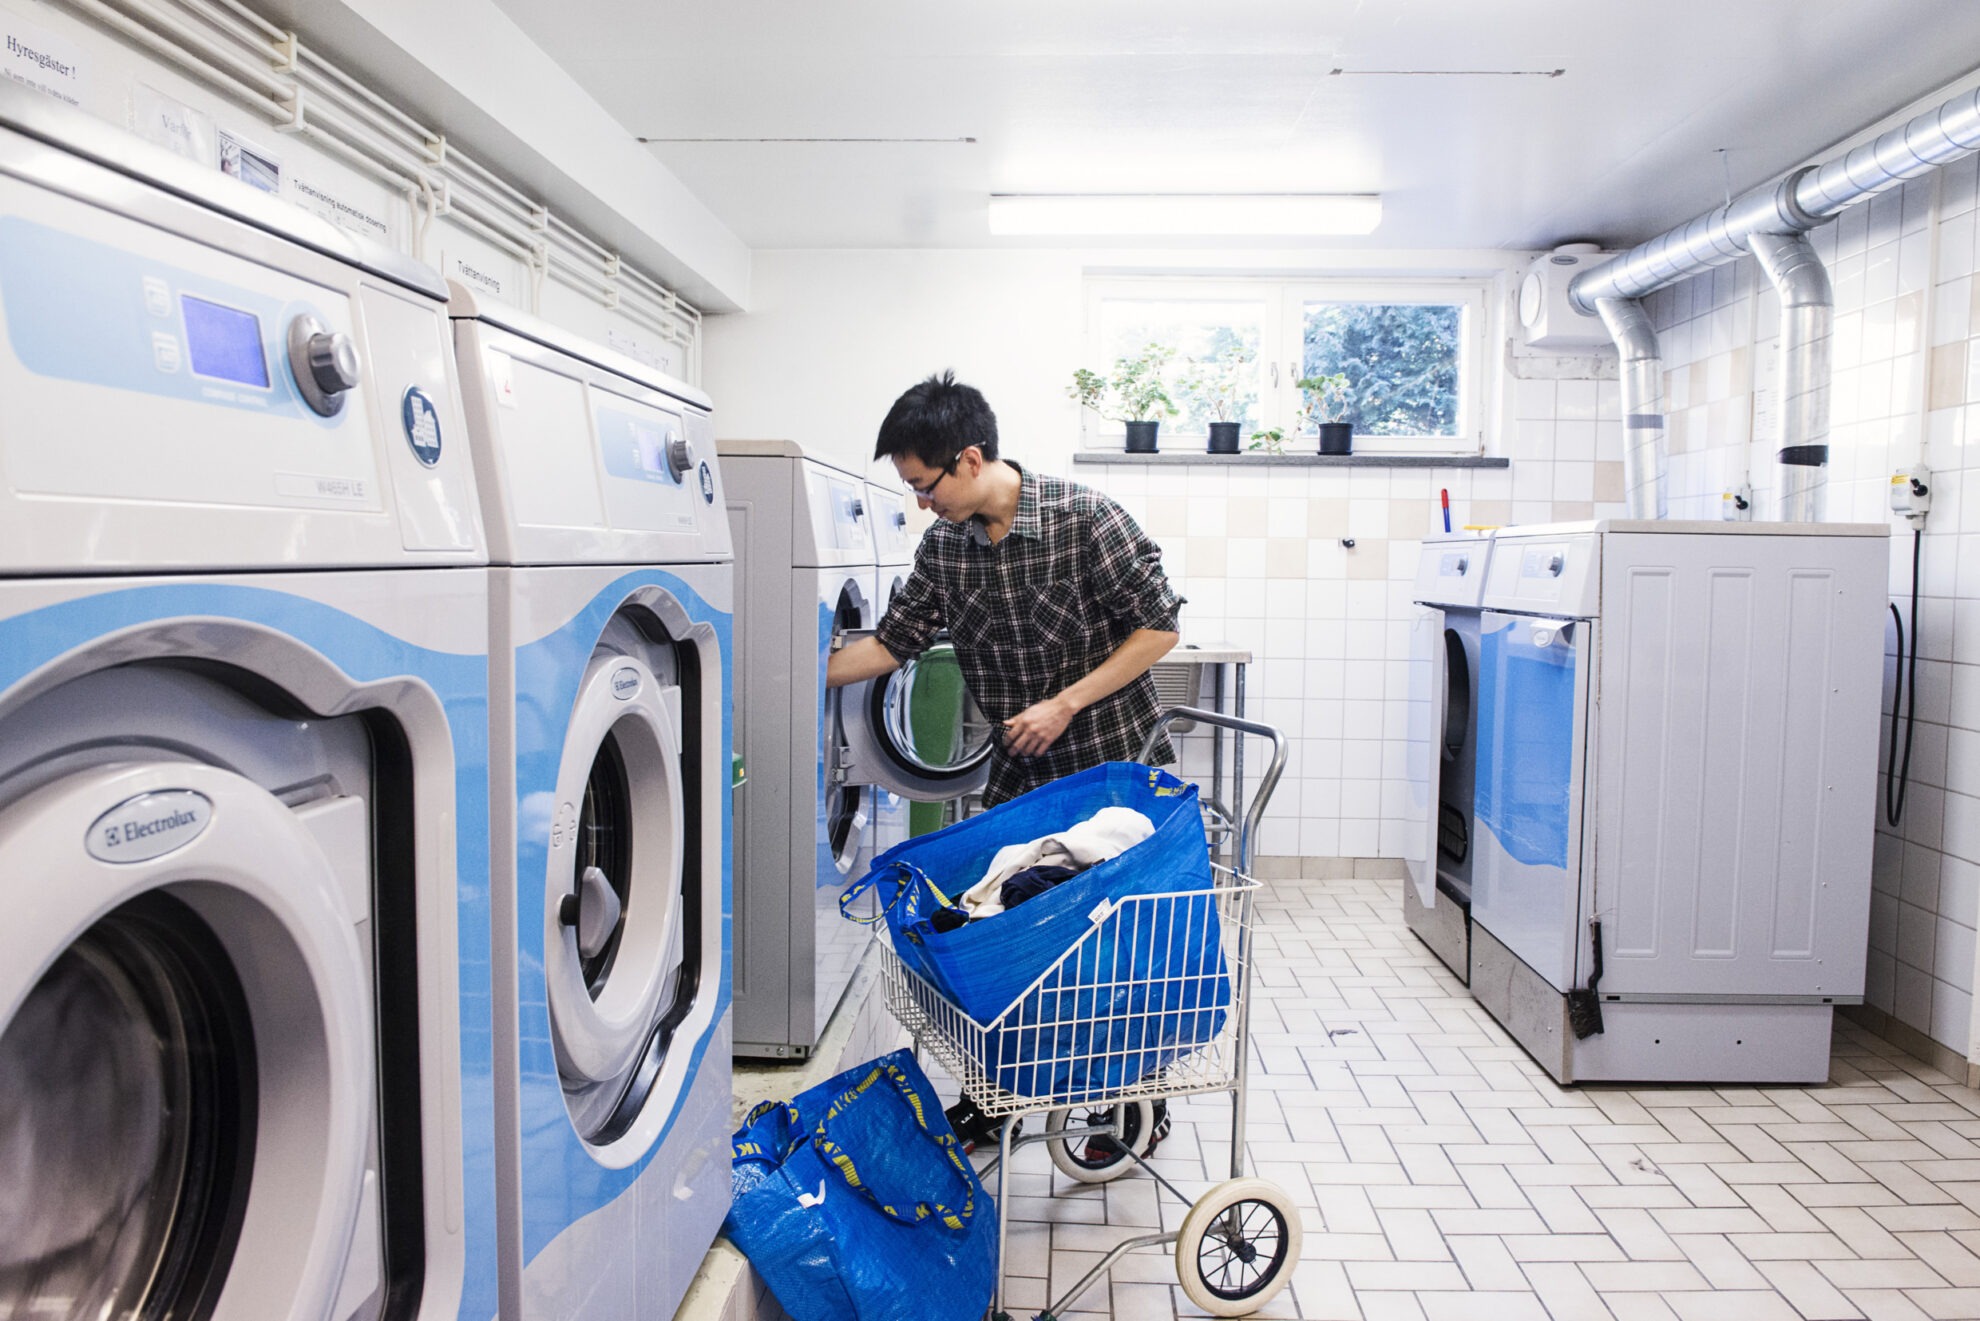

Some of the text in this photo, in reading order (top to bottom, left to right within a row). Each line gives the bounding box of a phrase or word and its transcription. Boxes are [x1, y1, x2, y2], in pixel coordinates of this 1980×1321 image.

[7, 35, 69, 76] Hyresgäster
[457, 259, 501, 294] Tvättanvisning
[124, 810, 197, 842] Electrolux
